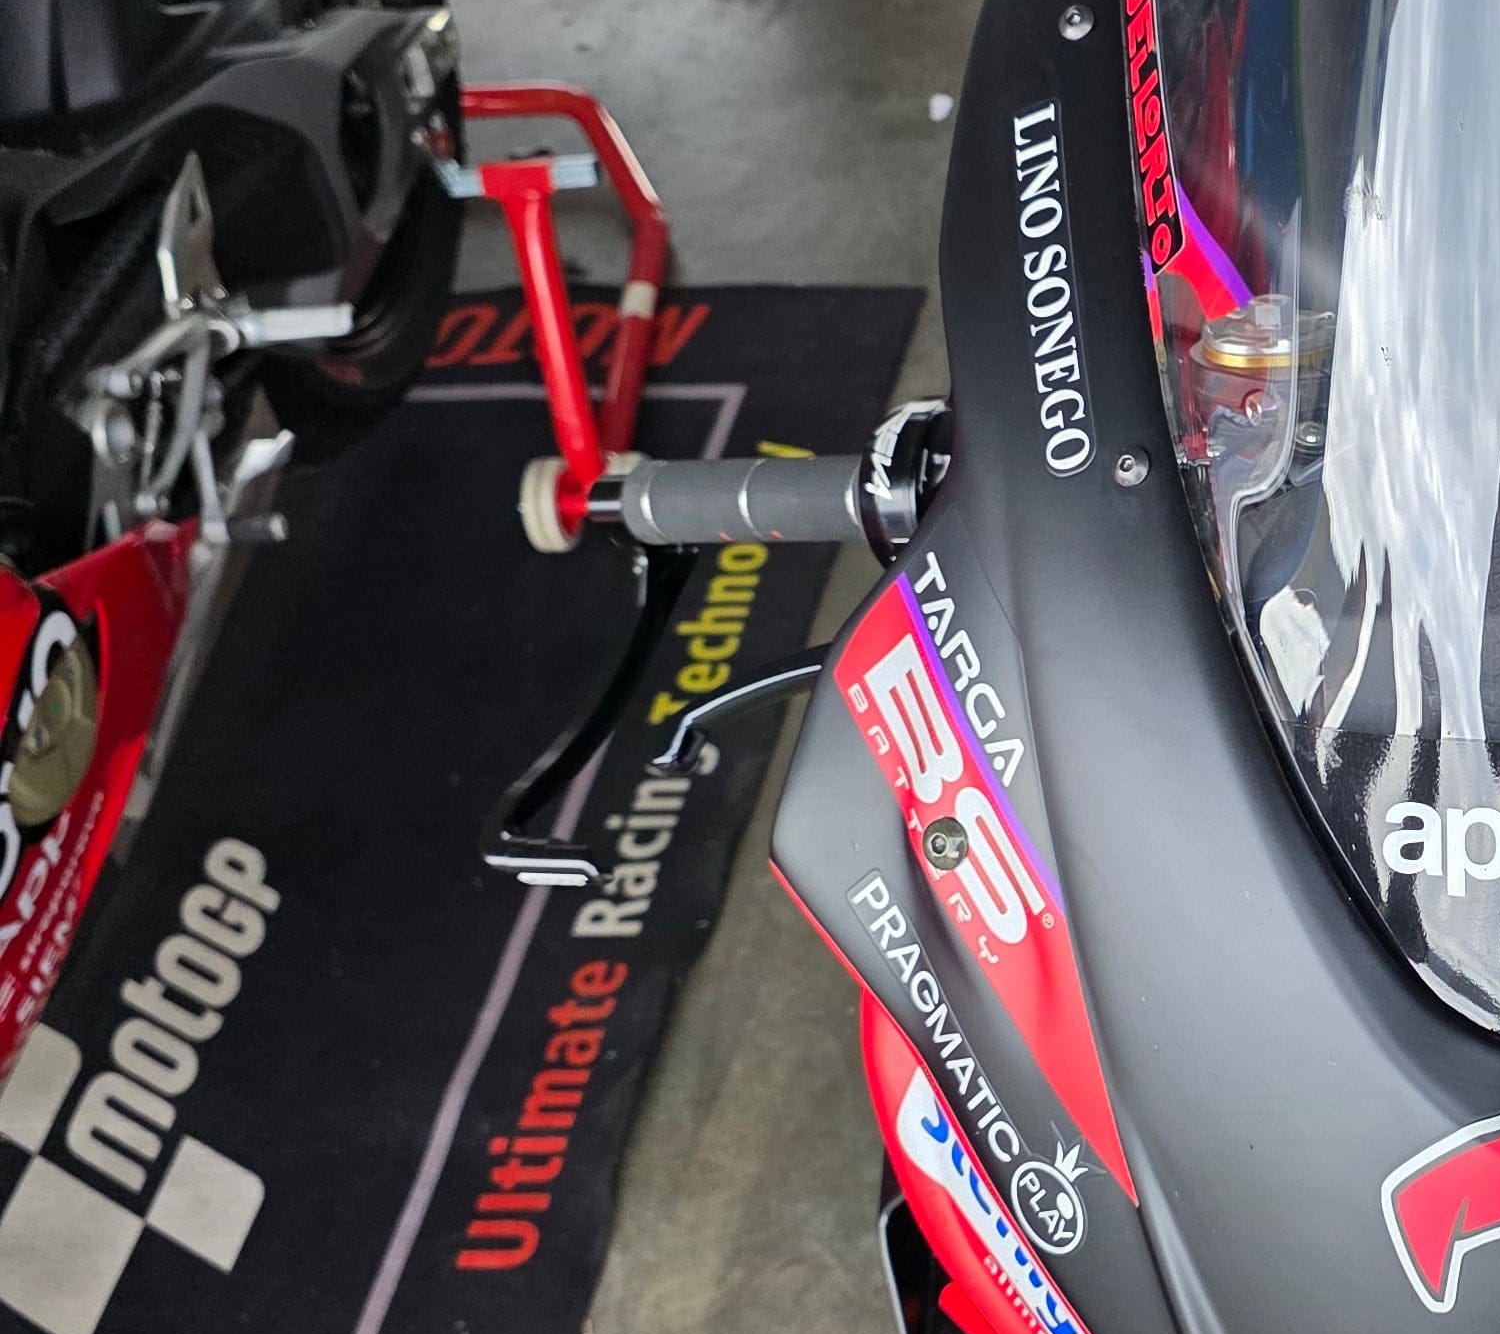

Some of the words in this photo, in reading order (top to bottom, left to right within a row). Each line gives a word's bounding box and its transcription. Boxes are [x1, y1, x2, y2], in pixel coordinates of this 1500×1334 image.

[1013, 103, 1062, 239] LINO
[1023, 244, 1091, 469] SONEGO
[914, 551, 1025, 787] TARGA
[455, 960, 627, 1271] Ultimate
[852, 875, 1020, 1163] PRAGMATIC
[1017, 1170, 1075, 1243] PLAY
